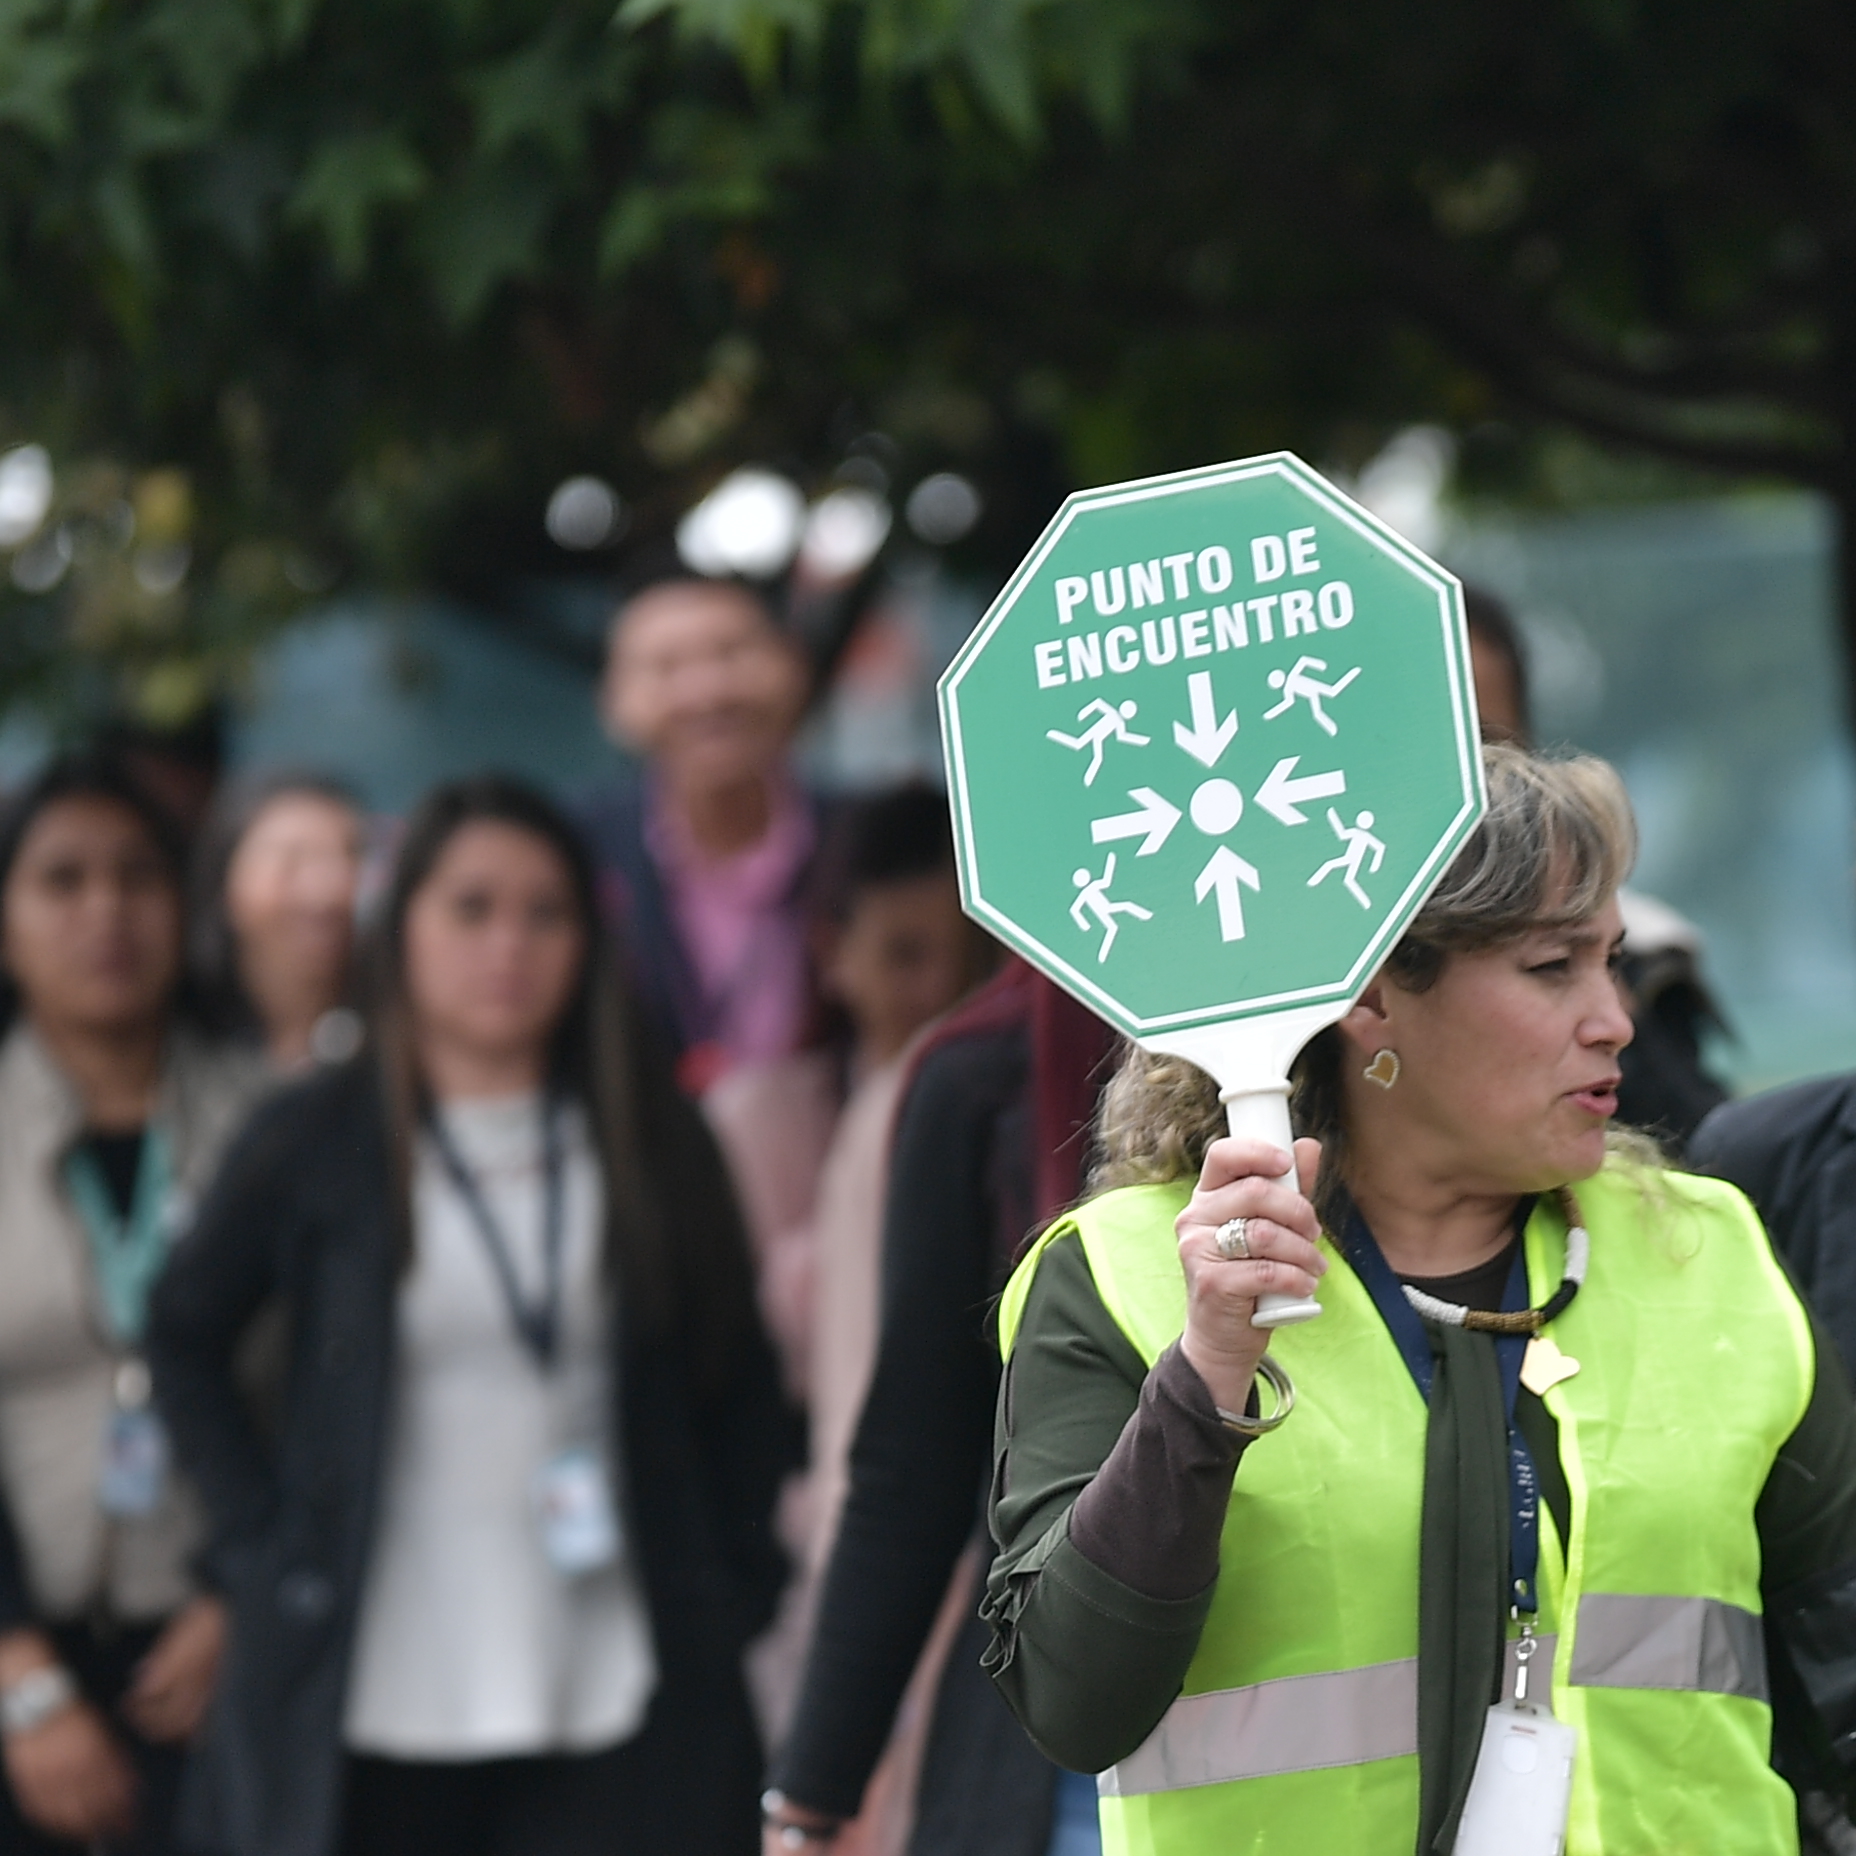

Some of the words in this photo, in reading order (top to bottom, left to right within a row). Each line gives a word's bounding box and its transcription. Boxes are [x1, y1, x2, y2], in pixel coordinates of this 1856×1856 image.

[1054, 545, 1233, 625] PUNTO
[1250, 526, 1321, 584] DE
[1034, 580, 1355, 689] ENCUENTRO
